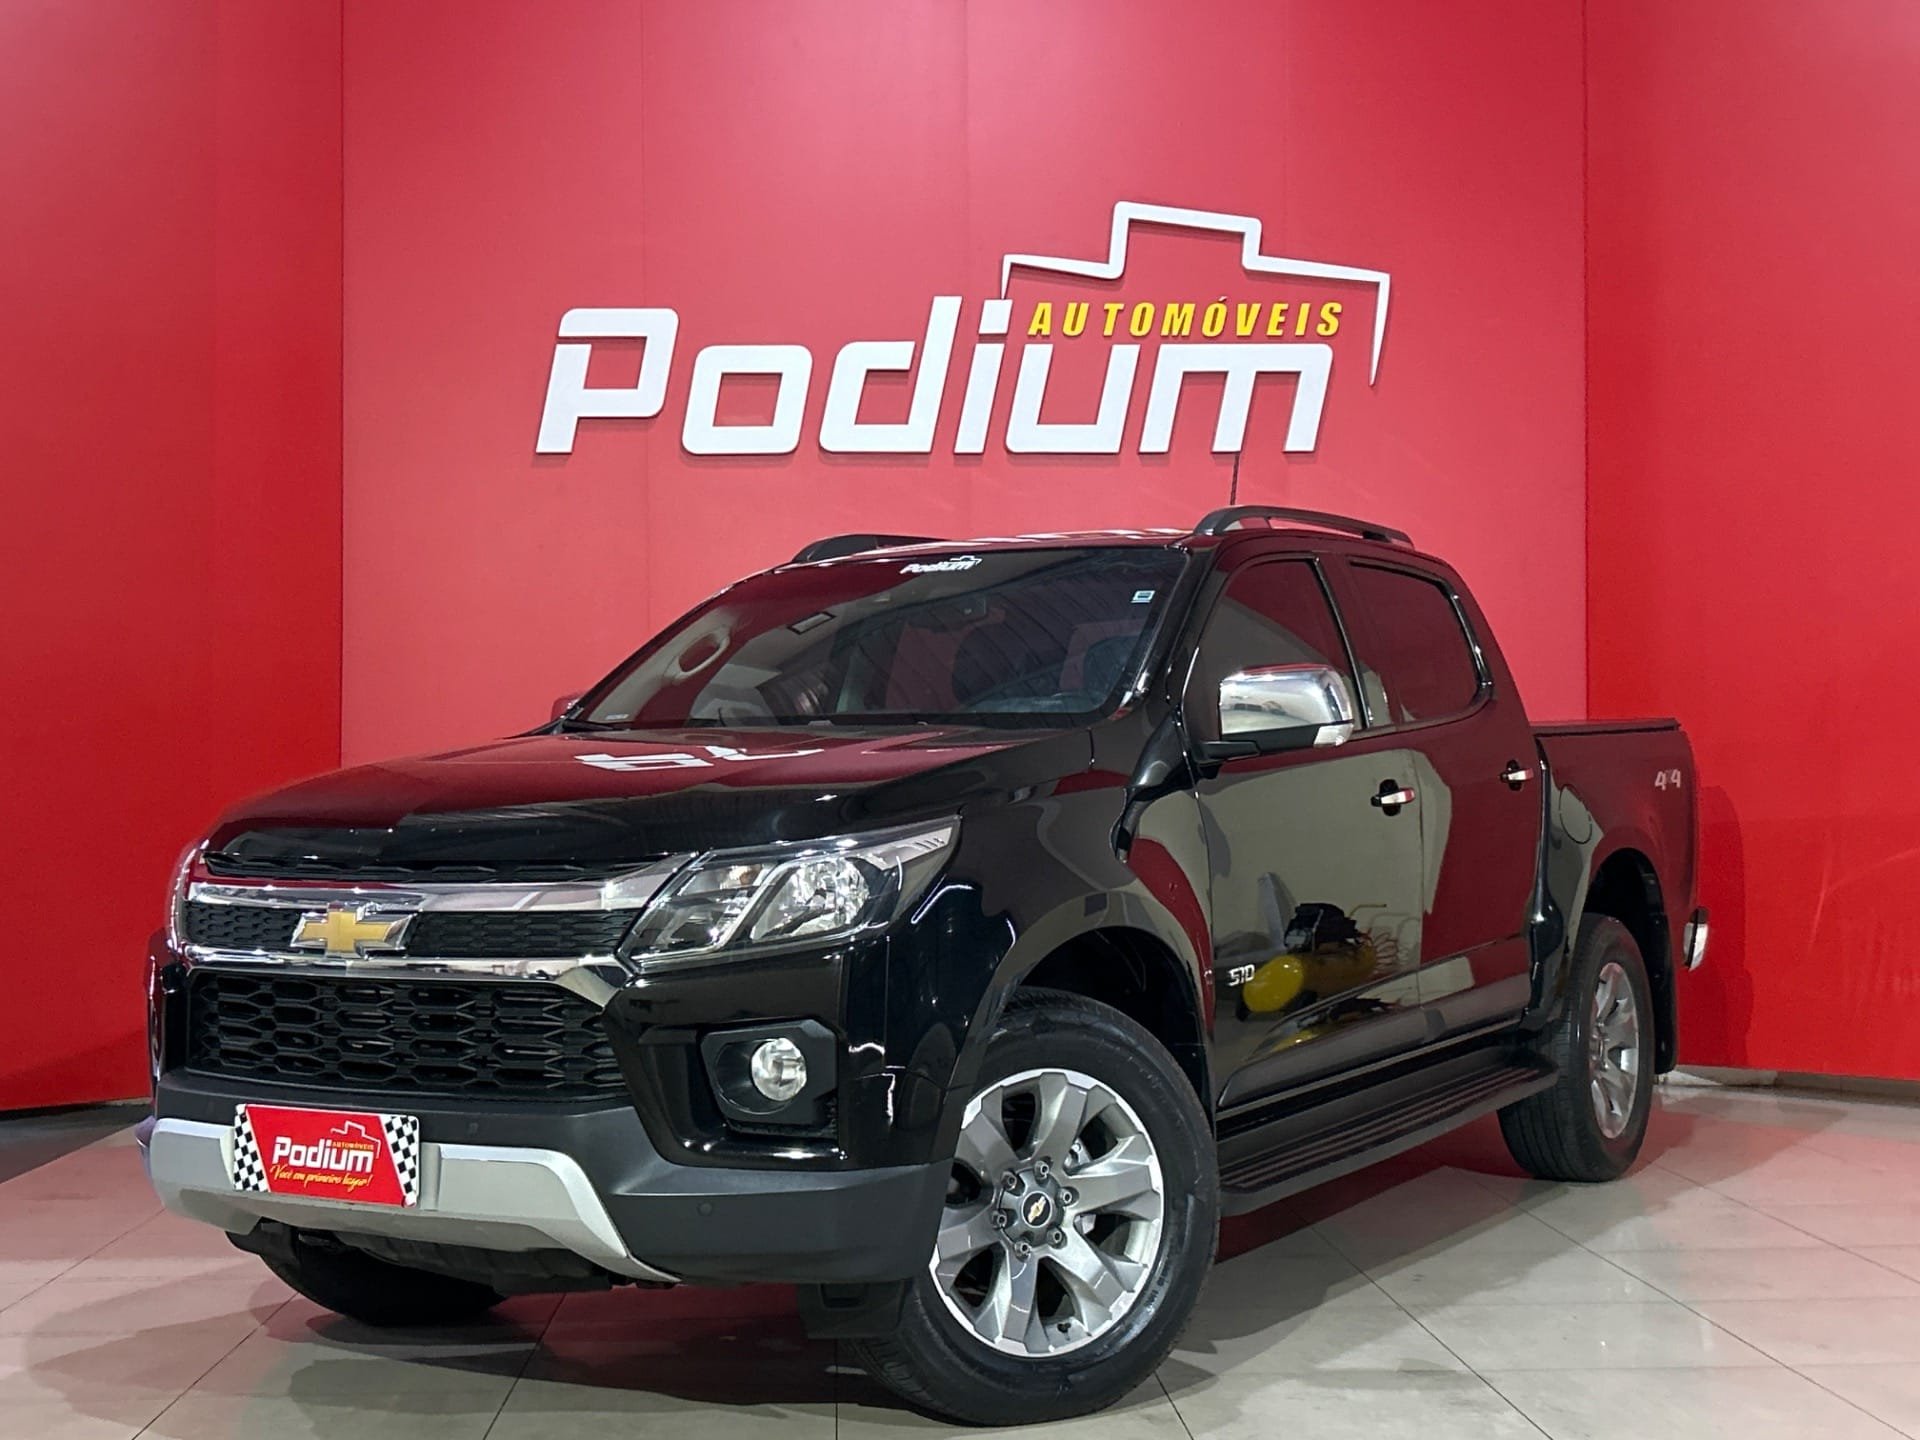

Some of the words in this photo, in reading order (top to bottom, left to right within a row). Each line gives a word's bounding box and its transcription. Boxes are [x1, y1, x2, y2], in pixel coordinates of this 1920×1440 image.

[1028, 296, 1343, 338] AUTOMÓVEIS
[535, 295, 1334, 454] Podium
[900, 560, 975, 574] Podium
[272, 1136, 375, 1173] Podium
